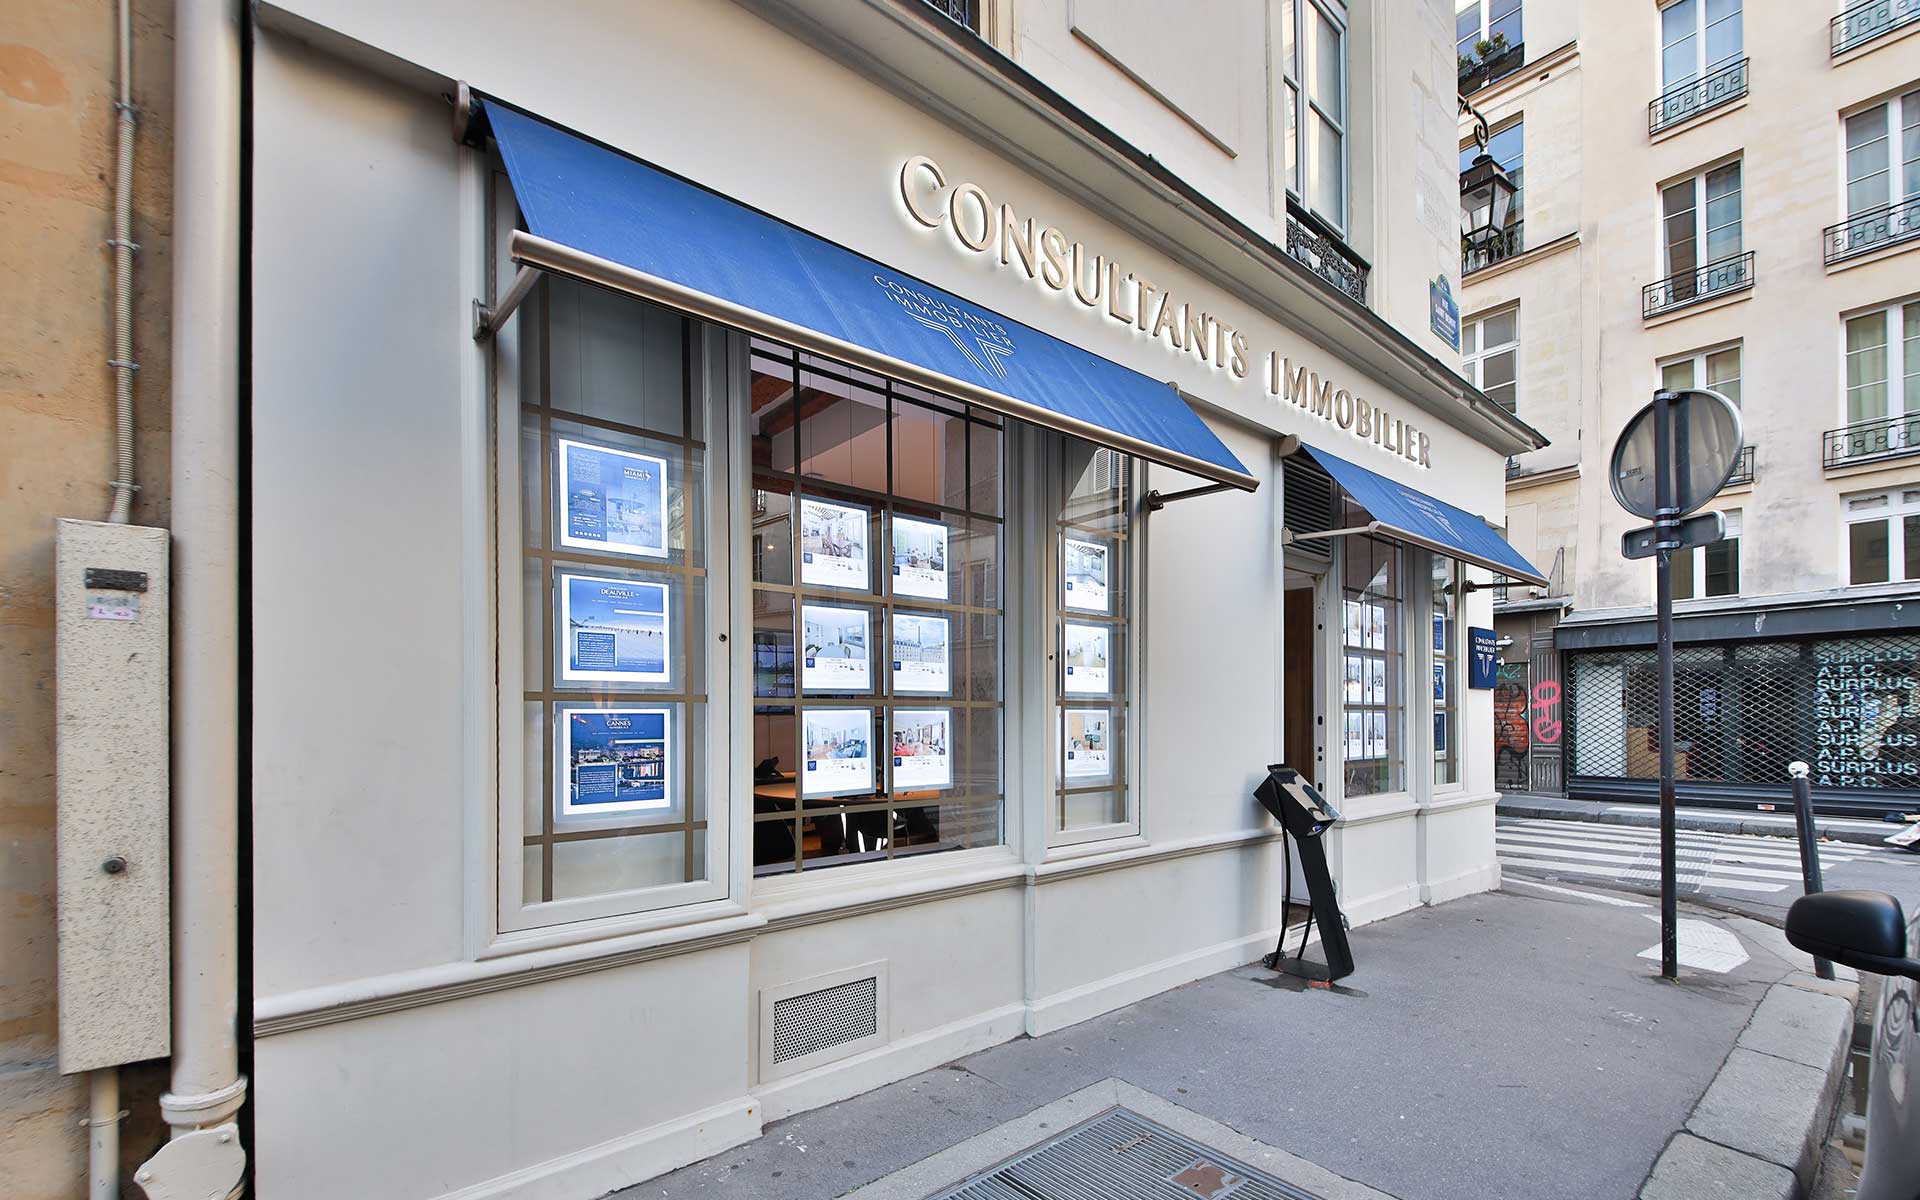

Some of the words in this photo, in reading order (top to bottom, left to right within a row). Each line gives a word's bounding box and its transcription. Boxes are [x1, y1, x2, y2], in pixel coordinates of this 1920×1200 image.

[873, 275, 1007, 336] CONSULTANTS
[900, 155, 1249, 378] CONSULTANTS
[1270, 350, 1432, 469] IMMOBILIER
[884, 290, 1017, 349] IMMOBILIER
[624, 469, 644, 479] MIAMI
[1816, 650, 1917, 664] SURPLUS
[1817, 664, 1882, 678] A.P.C.
[1817, 677, 1919, 691] SURPLUS
[1817, 761, 1919, 775] SURPLUS
[1818, 775, 1882, 788] A.P.C.
